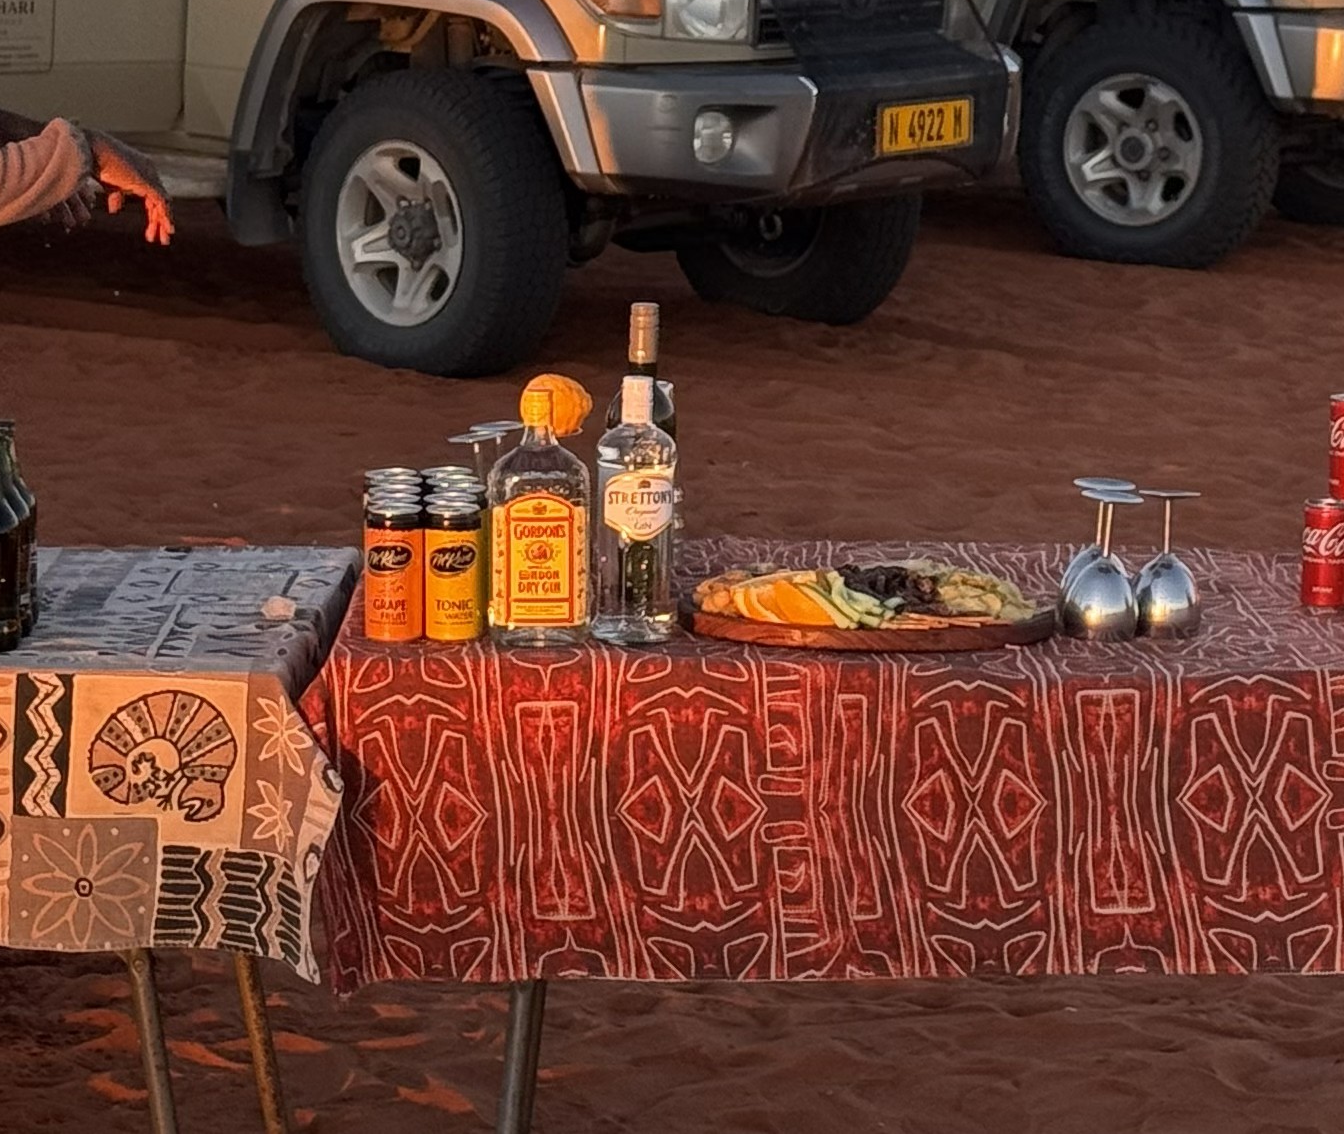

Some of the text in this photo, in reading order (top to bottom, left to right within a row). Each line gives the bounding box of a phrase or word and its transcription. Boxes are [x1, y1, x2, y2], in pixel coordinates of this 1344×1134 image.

[909, 108, 945, 143] 4922
[514, 523, 566, 541] GORDON'S
[373, 598, 406, 611] GRAPE
[436, 598, 474, 612] TONIC
